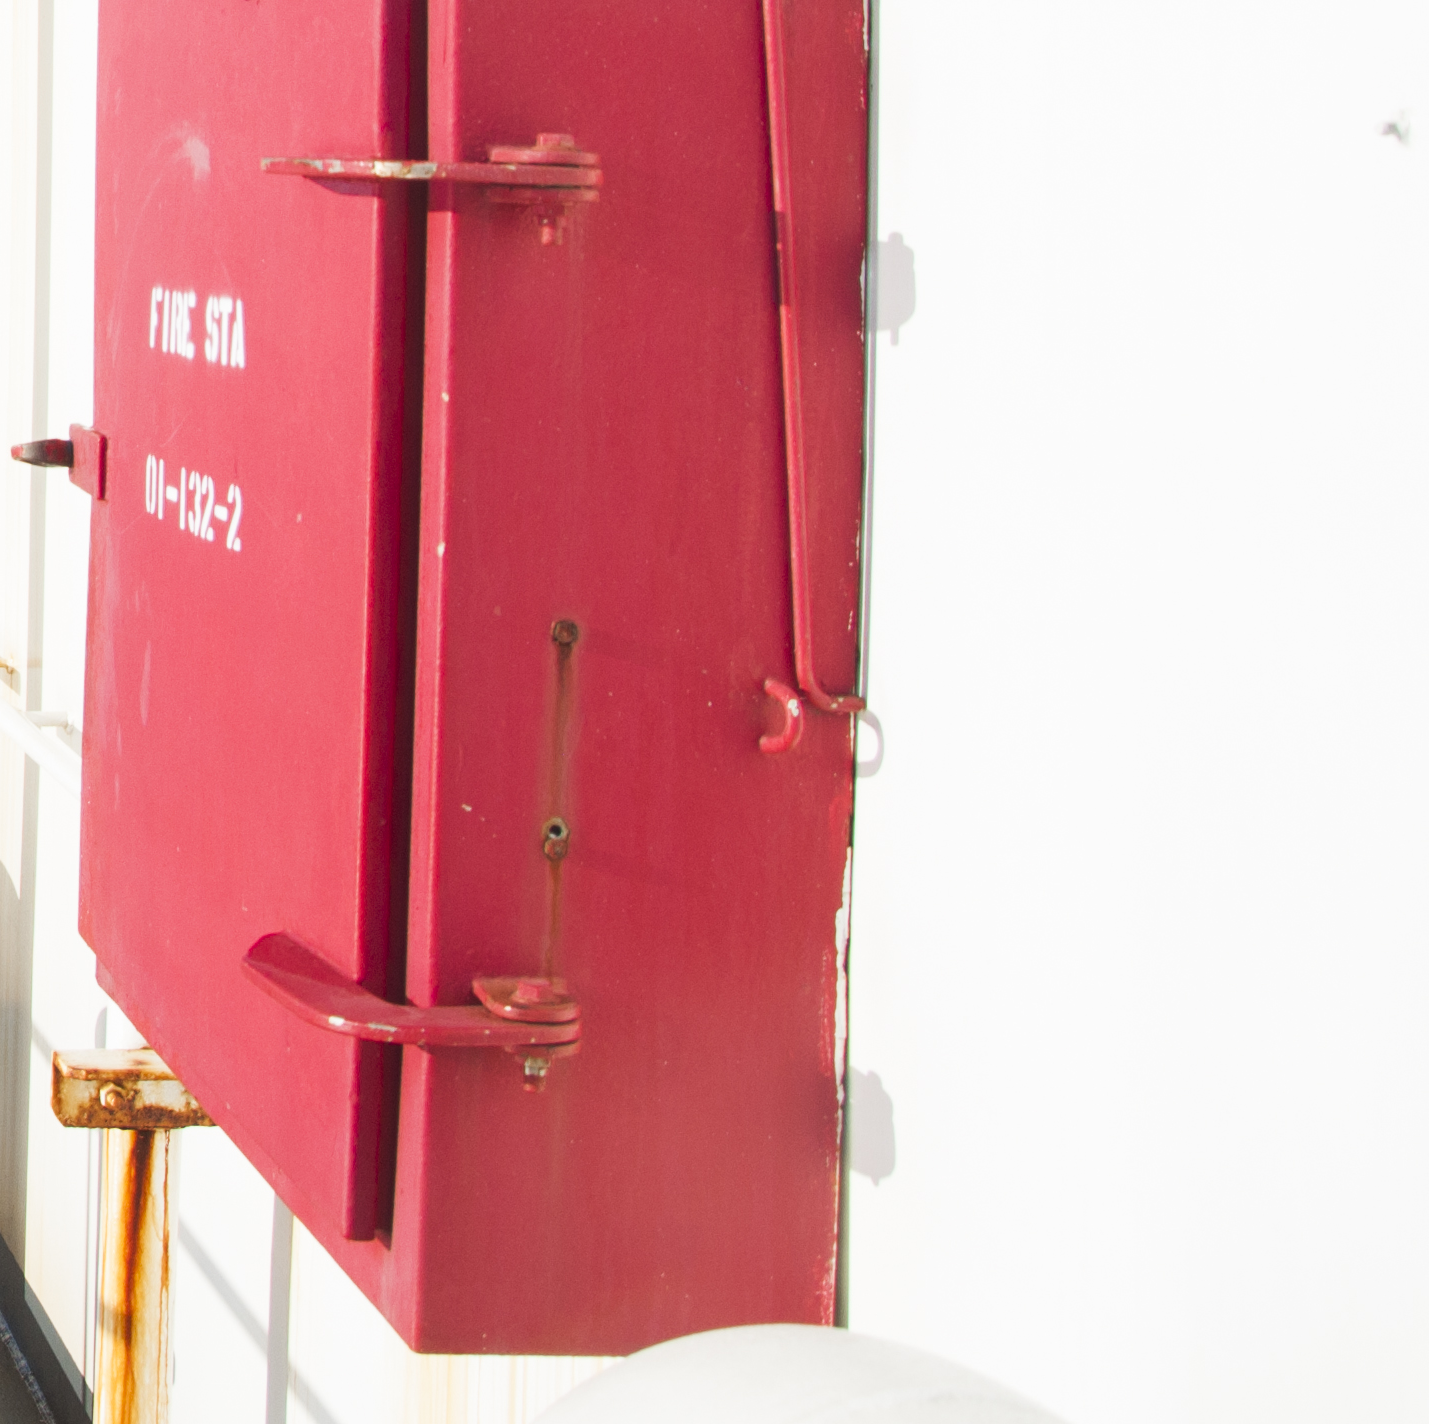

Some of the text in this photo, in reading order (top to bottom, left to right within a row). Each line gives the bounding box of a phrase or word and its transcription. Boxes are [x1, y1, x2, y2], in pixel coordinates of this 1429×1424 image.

[149, 286, 246, 370] FIRE STA
[145, 453, 242, 552] 01-132-2
